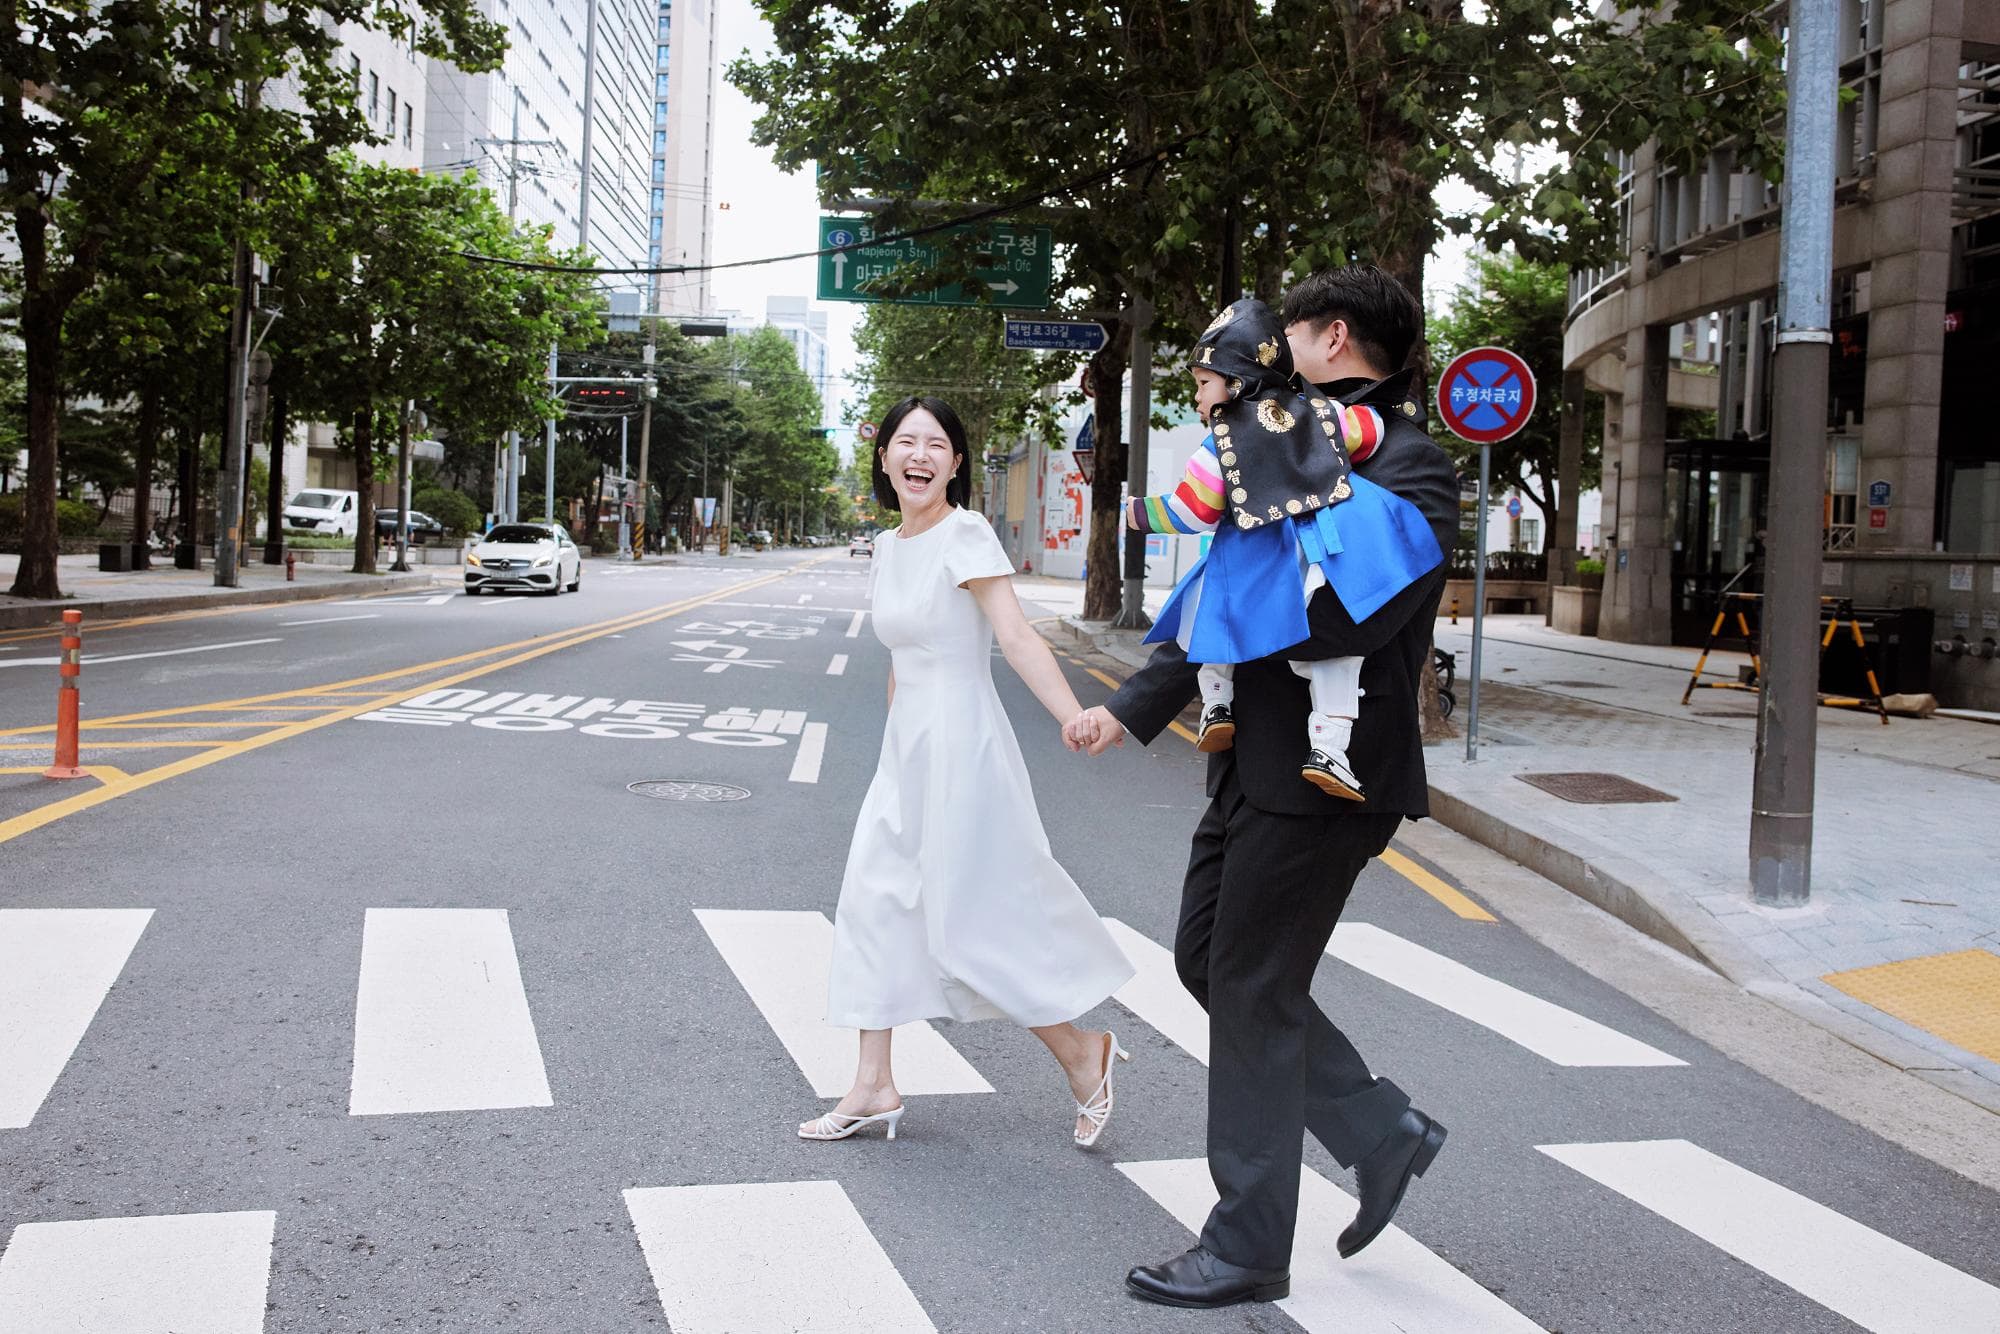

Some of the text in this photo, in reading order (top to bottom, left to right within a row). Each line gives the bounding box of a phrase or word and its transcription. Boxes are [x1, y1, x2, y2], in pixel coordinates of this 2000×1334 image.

[837, 231, 846, 245] 6
[957, 232, 1037, 256] 산구청
[909, 247, 927, 258] Stn
[1015, 258, 1032, 272] Ofc
[1009, 324, 1069, 338] 백범로36길
[1451, 387, 1521, 403] 주정차금지
[1226, 469, 1241, 486] 智
[1305, 494, 1321, 509] 信
[1268, 505, 1283, 521] 忠
[353, 687, 807, 747] 일방통행
